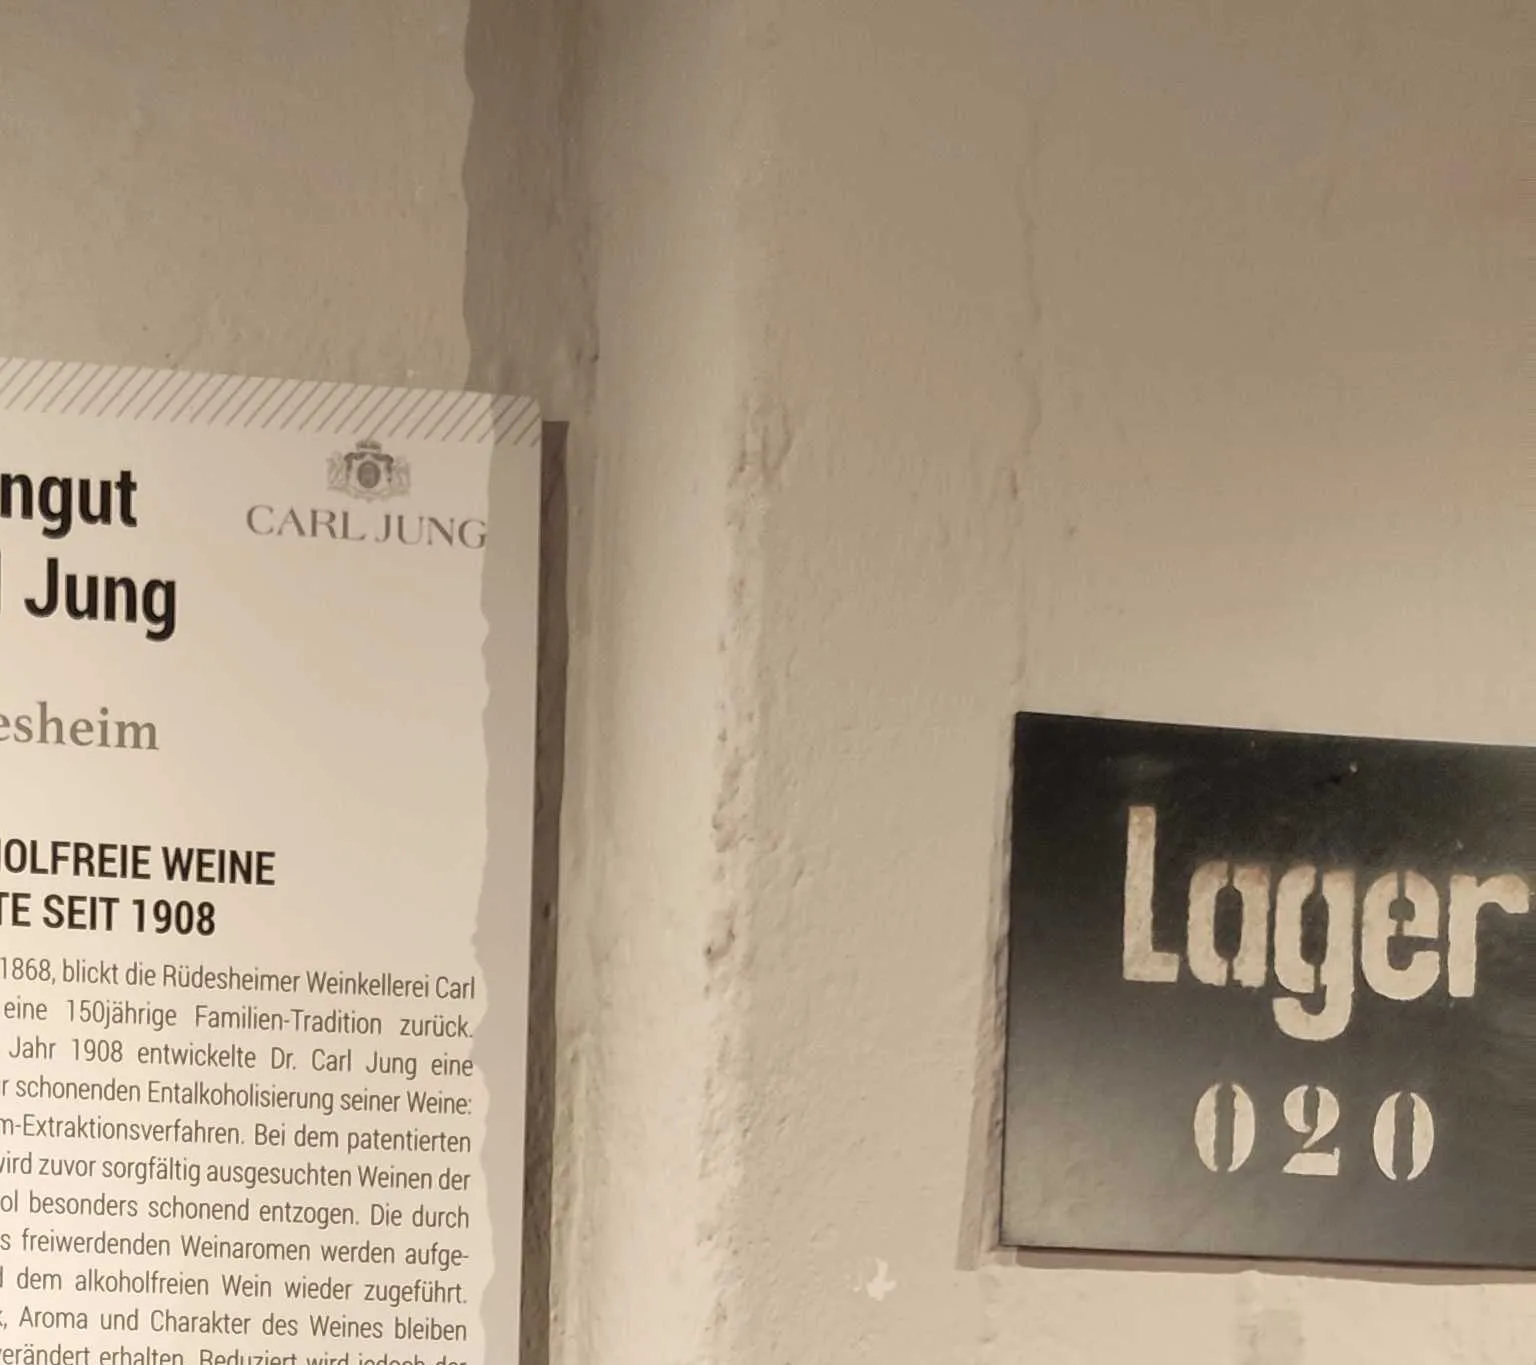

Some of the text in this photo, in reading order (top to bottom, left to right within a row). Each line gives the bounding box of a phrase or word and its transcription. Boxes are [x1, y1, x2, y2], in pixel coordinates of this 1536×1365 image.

[246, 504, 487, 549] CARL JUNG
[25, 557, 178, 642] Jung
[162, 847, 276, 887] WEINE
[43, 893, 120, 931] SEIT
[134, 899, 216, 936] 1908
[1123, 805, 1531, 1041] Lager
[0, 956, 56, 986] 1868,
[62, 957, 120, 986] blickt
[124, 960, 157, 987] die
[162, 963, 302, 993] Rüdesheimer
[305, 970, 430, 999] Weinkellerei
[435, 975, 476, 1000] Carl
[3, 994, 49, 1021] eine
[65, 999, 178, 1033] 150jährige
[195, 1004, 382, 1036] Familien-Tradition
[399, 1013, 474, 1044] zurück.
[15, 1073, 142, 1103] schonenden
[147, 1079, 335, 1117] Entalkoholisierung
[339, 1087, 402, 1113] seiner
[405, 1089, 473, 1116] Weine:
[254, 1121, 286, 1147] Bei
[293, 1122, 340, 1149] dem
[346, 1127, 472, 1156] patentierten
[37, 1157, 97, 1178] zuvor
[101, 1155, 201, 1188] sorgfältig
[205, 1161, 352, 1191] ausgesuchten
[356, 1164, 433, 1191] Weinen
[438, 1166, 472, 1192] der
[29, 1188, 139, 1218] besonders
[147, 1194, 251, 1222] schonend
[258, 1201, 360, 1231] entzogen.
[370, 1201, 403, 1228] Die
[411, 1203, 470, 1230] durch
[16, 1265, 63, 1291] dem
[74, 1267, 209, 1297] alkoholfreien
[221, 1273, 272, 1299] Wein
[283, 1274, 355, 1301] wieder
[363, 1278, 468, 1308] zugeführt.
[18, 1305, 89, 1330] Aroma
[100, 1307, 140, 1332] und
[150, 1308, 252, 1336] Charakter
[261, 1311, 299, 1337] des
[309, 1313, 384, 1340] Weines
[394, 1315, 468, 1342] bleiben
